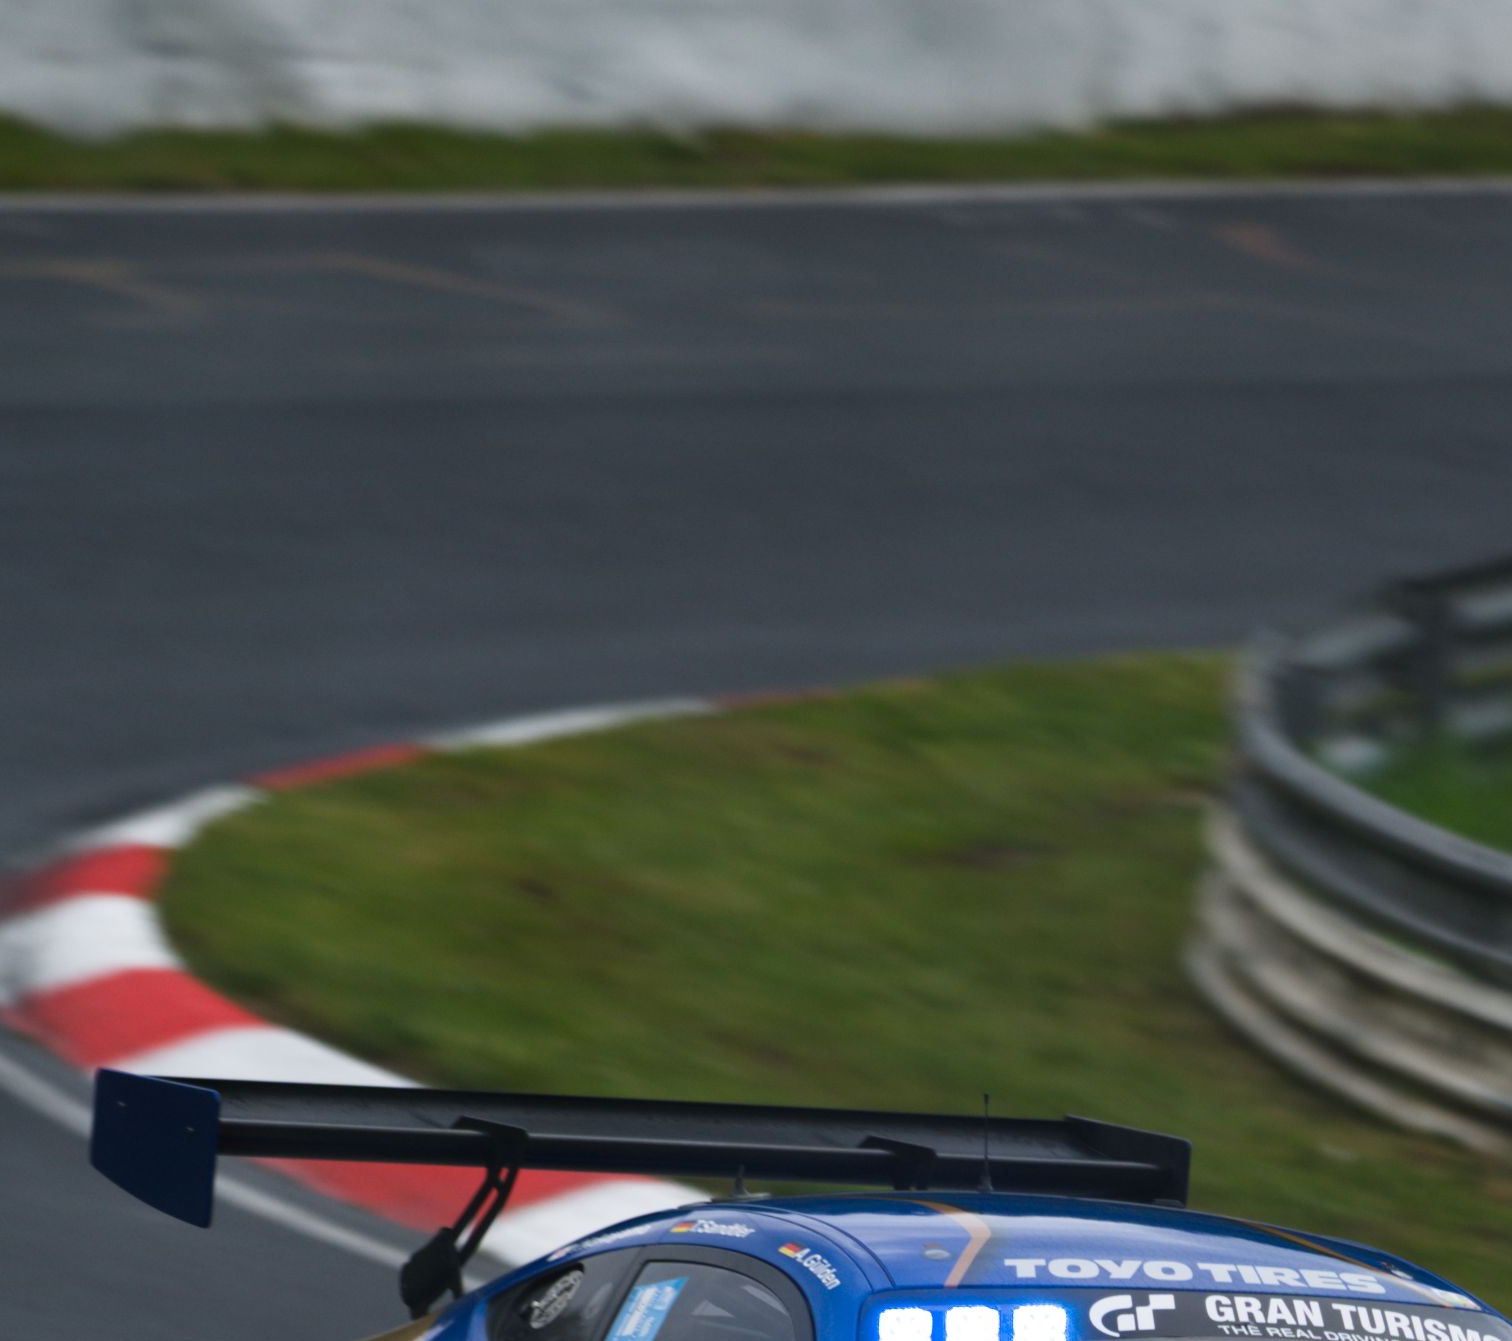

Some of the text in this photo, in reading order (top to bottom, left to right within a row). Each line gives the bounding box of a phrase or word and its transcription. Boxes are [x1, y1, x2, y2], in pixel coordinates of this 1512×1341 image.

[1004, 1258, 1386, 1294] TOYO TIRES
[1205, 1295, 1324, 1328] GRAN
[1218, 1325, 1262, 1337] THE
[1267, 1326, 1322, 1341] REAL
